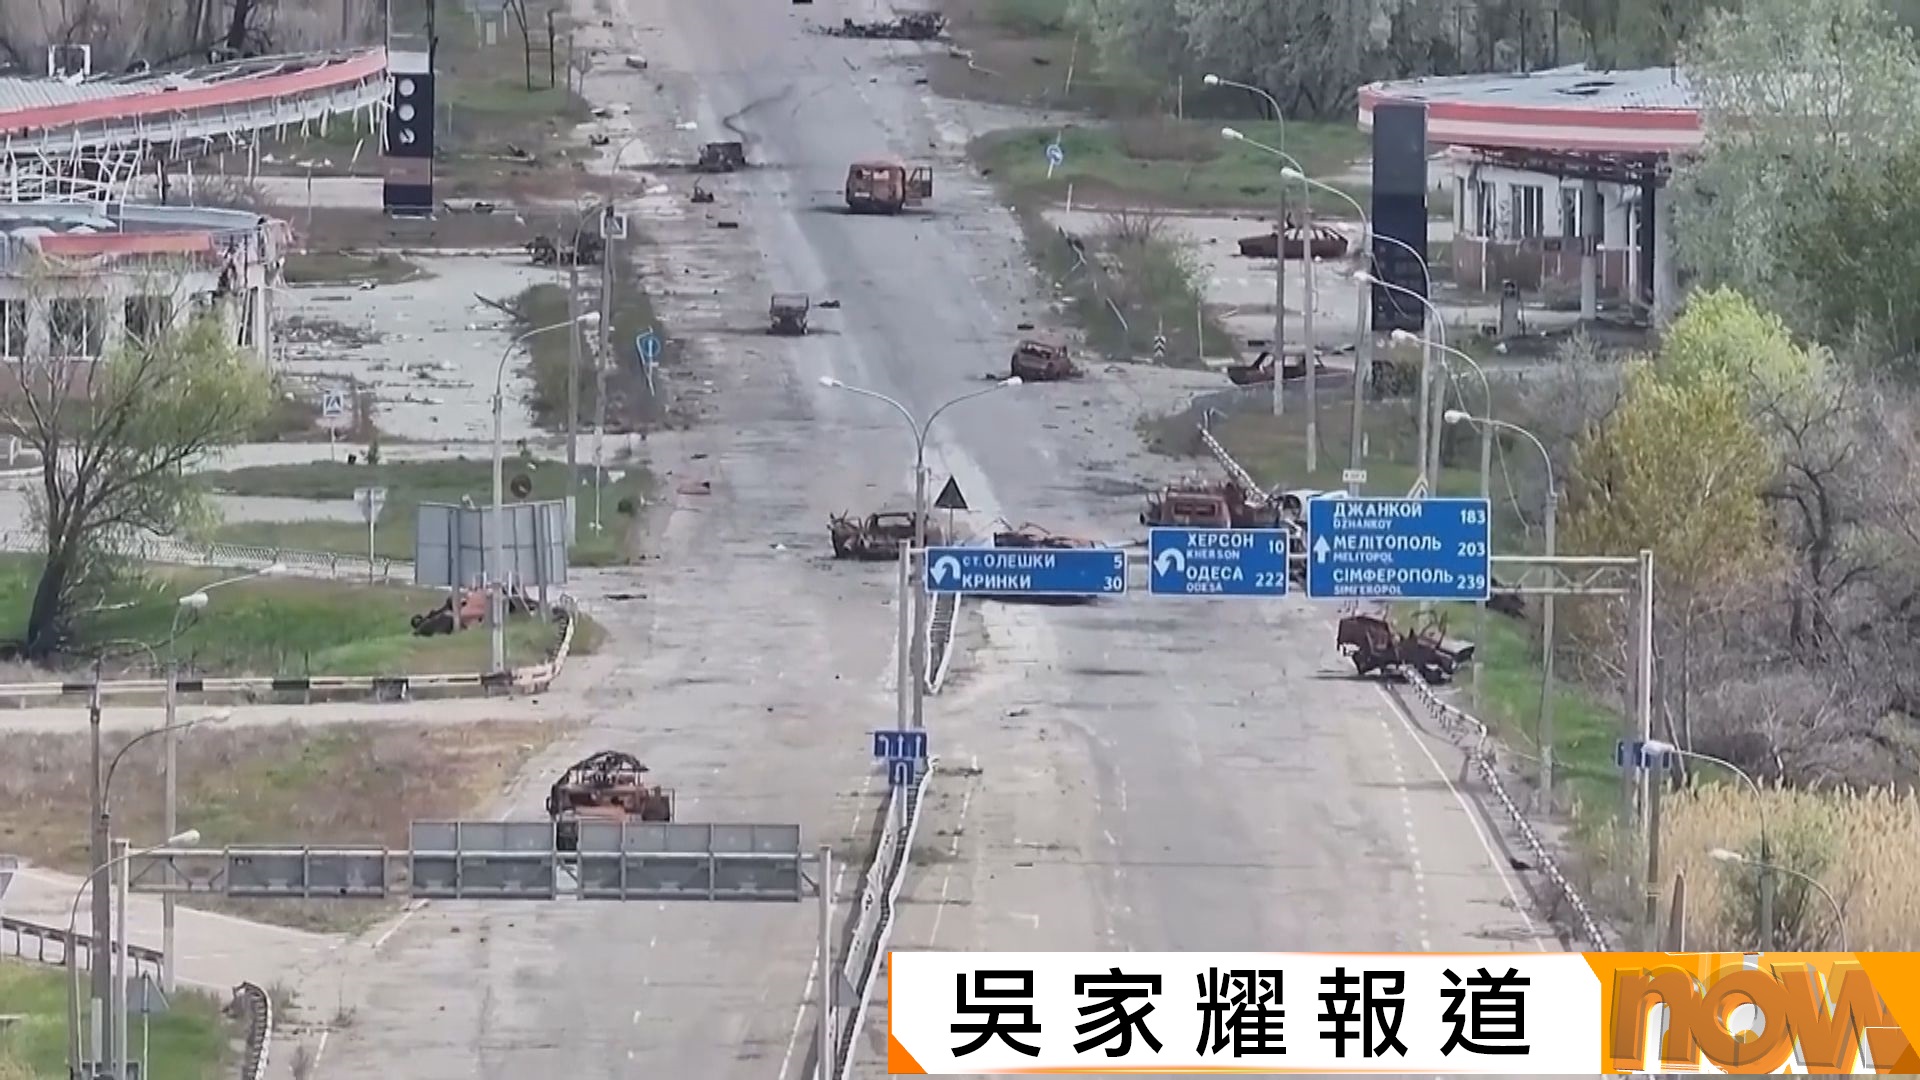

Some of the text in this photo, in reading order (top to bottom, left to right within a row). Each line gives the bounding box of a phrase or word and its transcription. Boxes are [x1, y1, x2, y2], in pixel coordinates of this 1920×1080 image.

[1333, 502, 1422, 517] ДЖАНКОЙ
[1333, 519, 1392, 530] DZHANKOY
[1460, 510, 1486, 525] 183
[1187, 533, 1255, 548] ХЕРСОН
[1268, 540, 1285, 554] 10
[1333, 535, 1442, 550] МЕЛІТОПОЛЬ
[1186, 549, 1240, 560] KHERSON
[1457, 542, 1485, 557] 203
[1113, 555, 1123, 570] 5
[1333, 552, 1393, 563] MELITOPOL
[1186, 566, 1244, 581] ОДЕСА
[1255, 572, 1284, 588] 222
[1333, 568, 1453, 583] СІМФЕРОПОЛЬ
[962, 574, 1122, 591] КРИНКИ 30
[1457, 575, 1485, 590] 239
